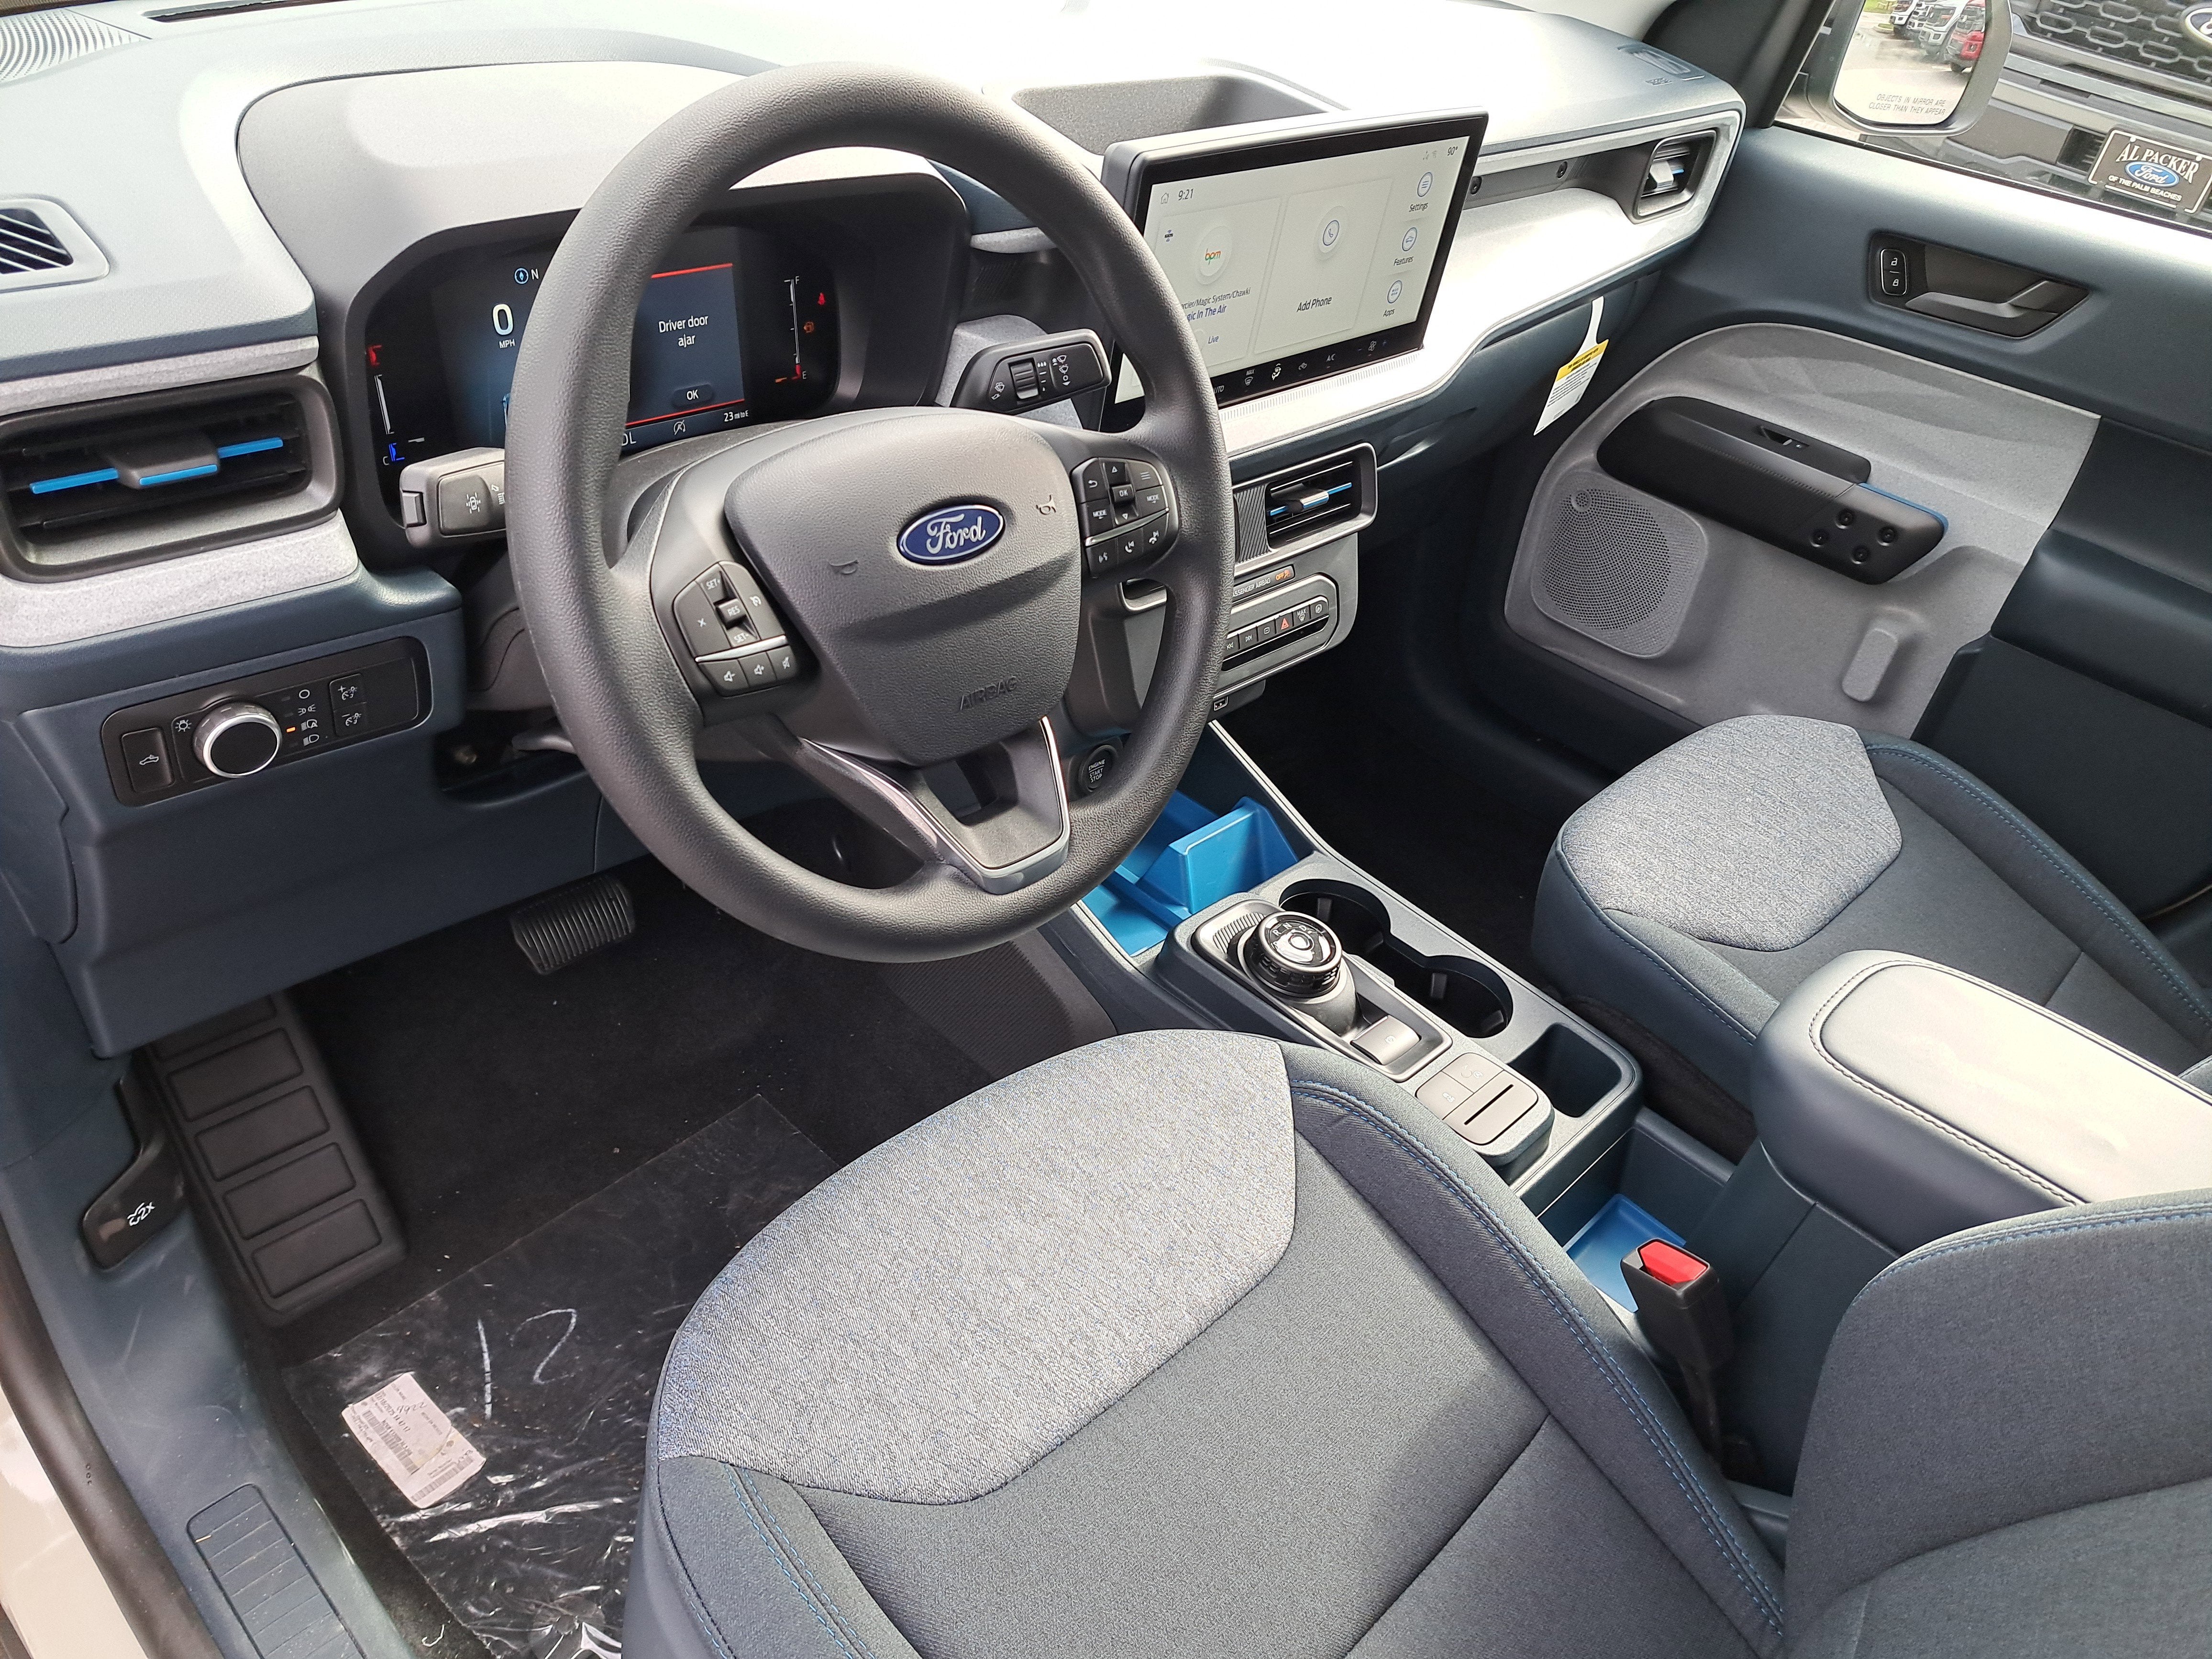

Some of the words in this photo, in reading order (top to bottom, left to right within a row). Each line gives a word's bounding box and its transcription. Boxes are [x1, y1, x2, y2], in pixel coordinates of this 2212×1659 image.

[1877, 94, 1902, 102] OBJECTS
[1869, 102, 1891, 110] CLOSER
[2115, 143, 2140, 163] AL
[2141, 148, 2199, 184] PACKER
[2135, 165, 2168, 184] Ford
[1178, 188, 1194, 200] 9:21
[2118, 177, 2132, 188] THE
[2132, 181, 2150, 192] PALM
[2150, 186, 2182, 202] BEACHES
[1409, 203, 1428, 212] Settings
[1205, 248, 1221, 265] bpm
[1394, 256, 1414, 266] Features
[531, 268, 539, 280] N
[1296, 300, 1311, 312] Add
[1311, 297, 1332, 309] Phone
[1197, 310, 1203, 319] In
[1205, 307, 1217, 317] The
[1217, 304, 1227, 314] Air
[1382, 309, 1395, 317] Apps
[493, 304, 513, 335] 0
[658, 319, 686, 333] Driver
[687, 315, 709, 328] door
[499, 339, 515, 349] MPH
[678, 334, 696, 348] ajar
[1208, 336, 1219, 344] Live
[686, 389, 699, 400] OK
[724, 411, 733, 422] 23
[926, 513, 986, 554] Ford
[1255, 577, 1271, 589] AIRBAG
[727, 605, 741, 617] RES
[960, 675, 1018, 710] AIRBAG
[1088, 759, 1106, 771] ENGINE
[1089, 768, 1103, 779] START
[1091, 774, 1103, 783] STOP
